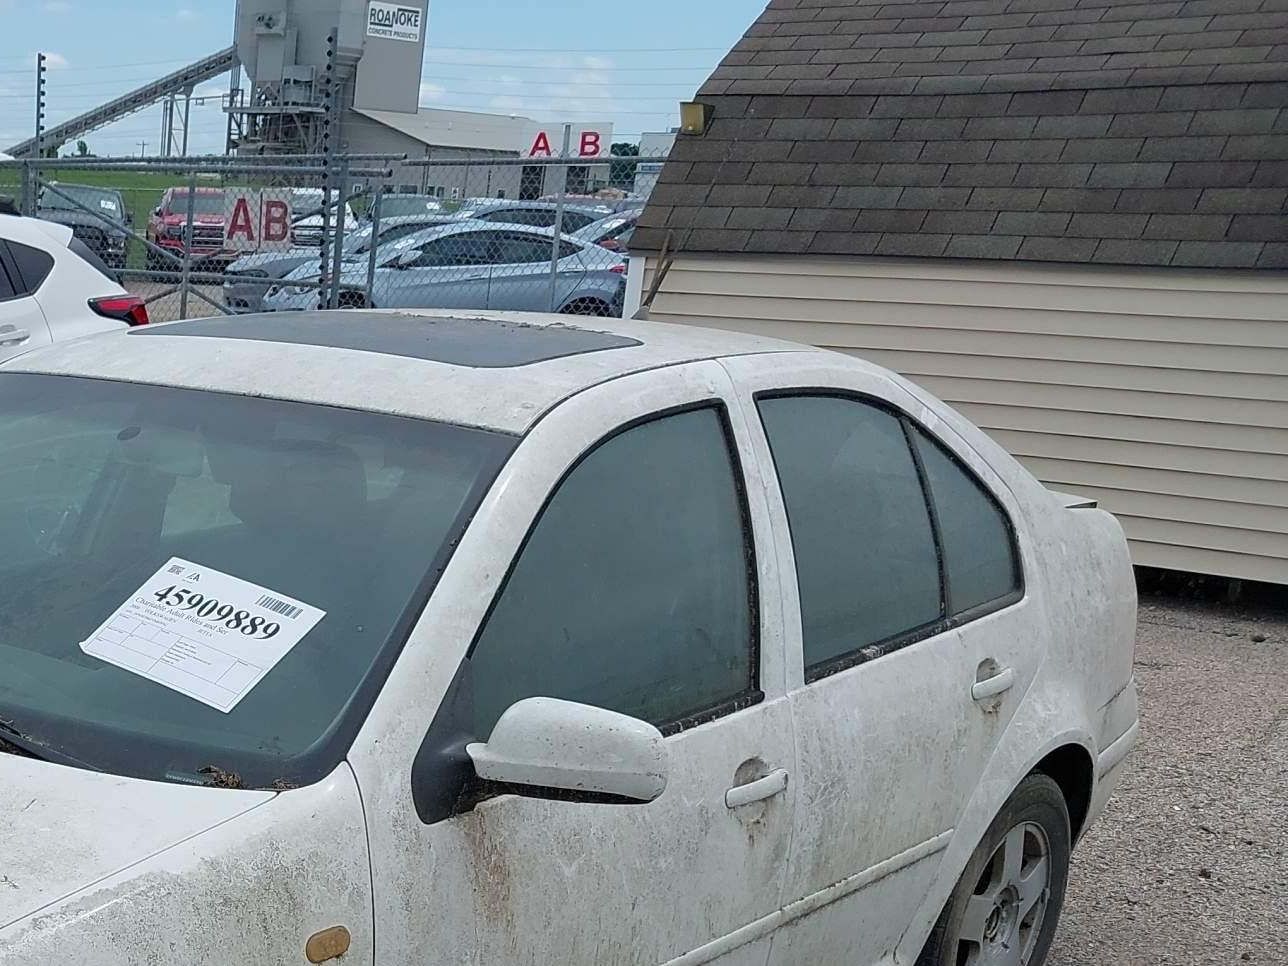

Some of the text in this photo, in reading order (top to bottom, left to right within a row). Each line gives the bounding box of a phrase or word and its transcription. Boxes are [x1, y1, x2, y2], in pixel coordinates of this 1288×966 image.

[370, 8, 419, 27] ROANOKE
[529, 131, 601, 157] A B
[227, 198, 289, 242] A B
[153, 584, 281, 640] 45909889
[168, 608, 185, 619] Adult
[186, 614, 203, 626] Rides
[204, 621, 217, 632] and
